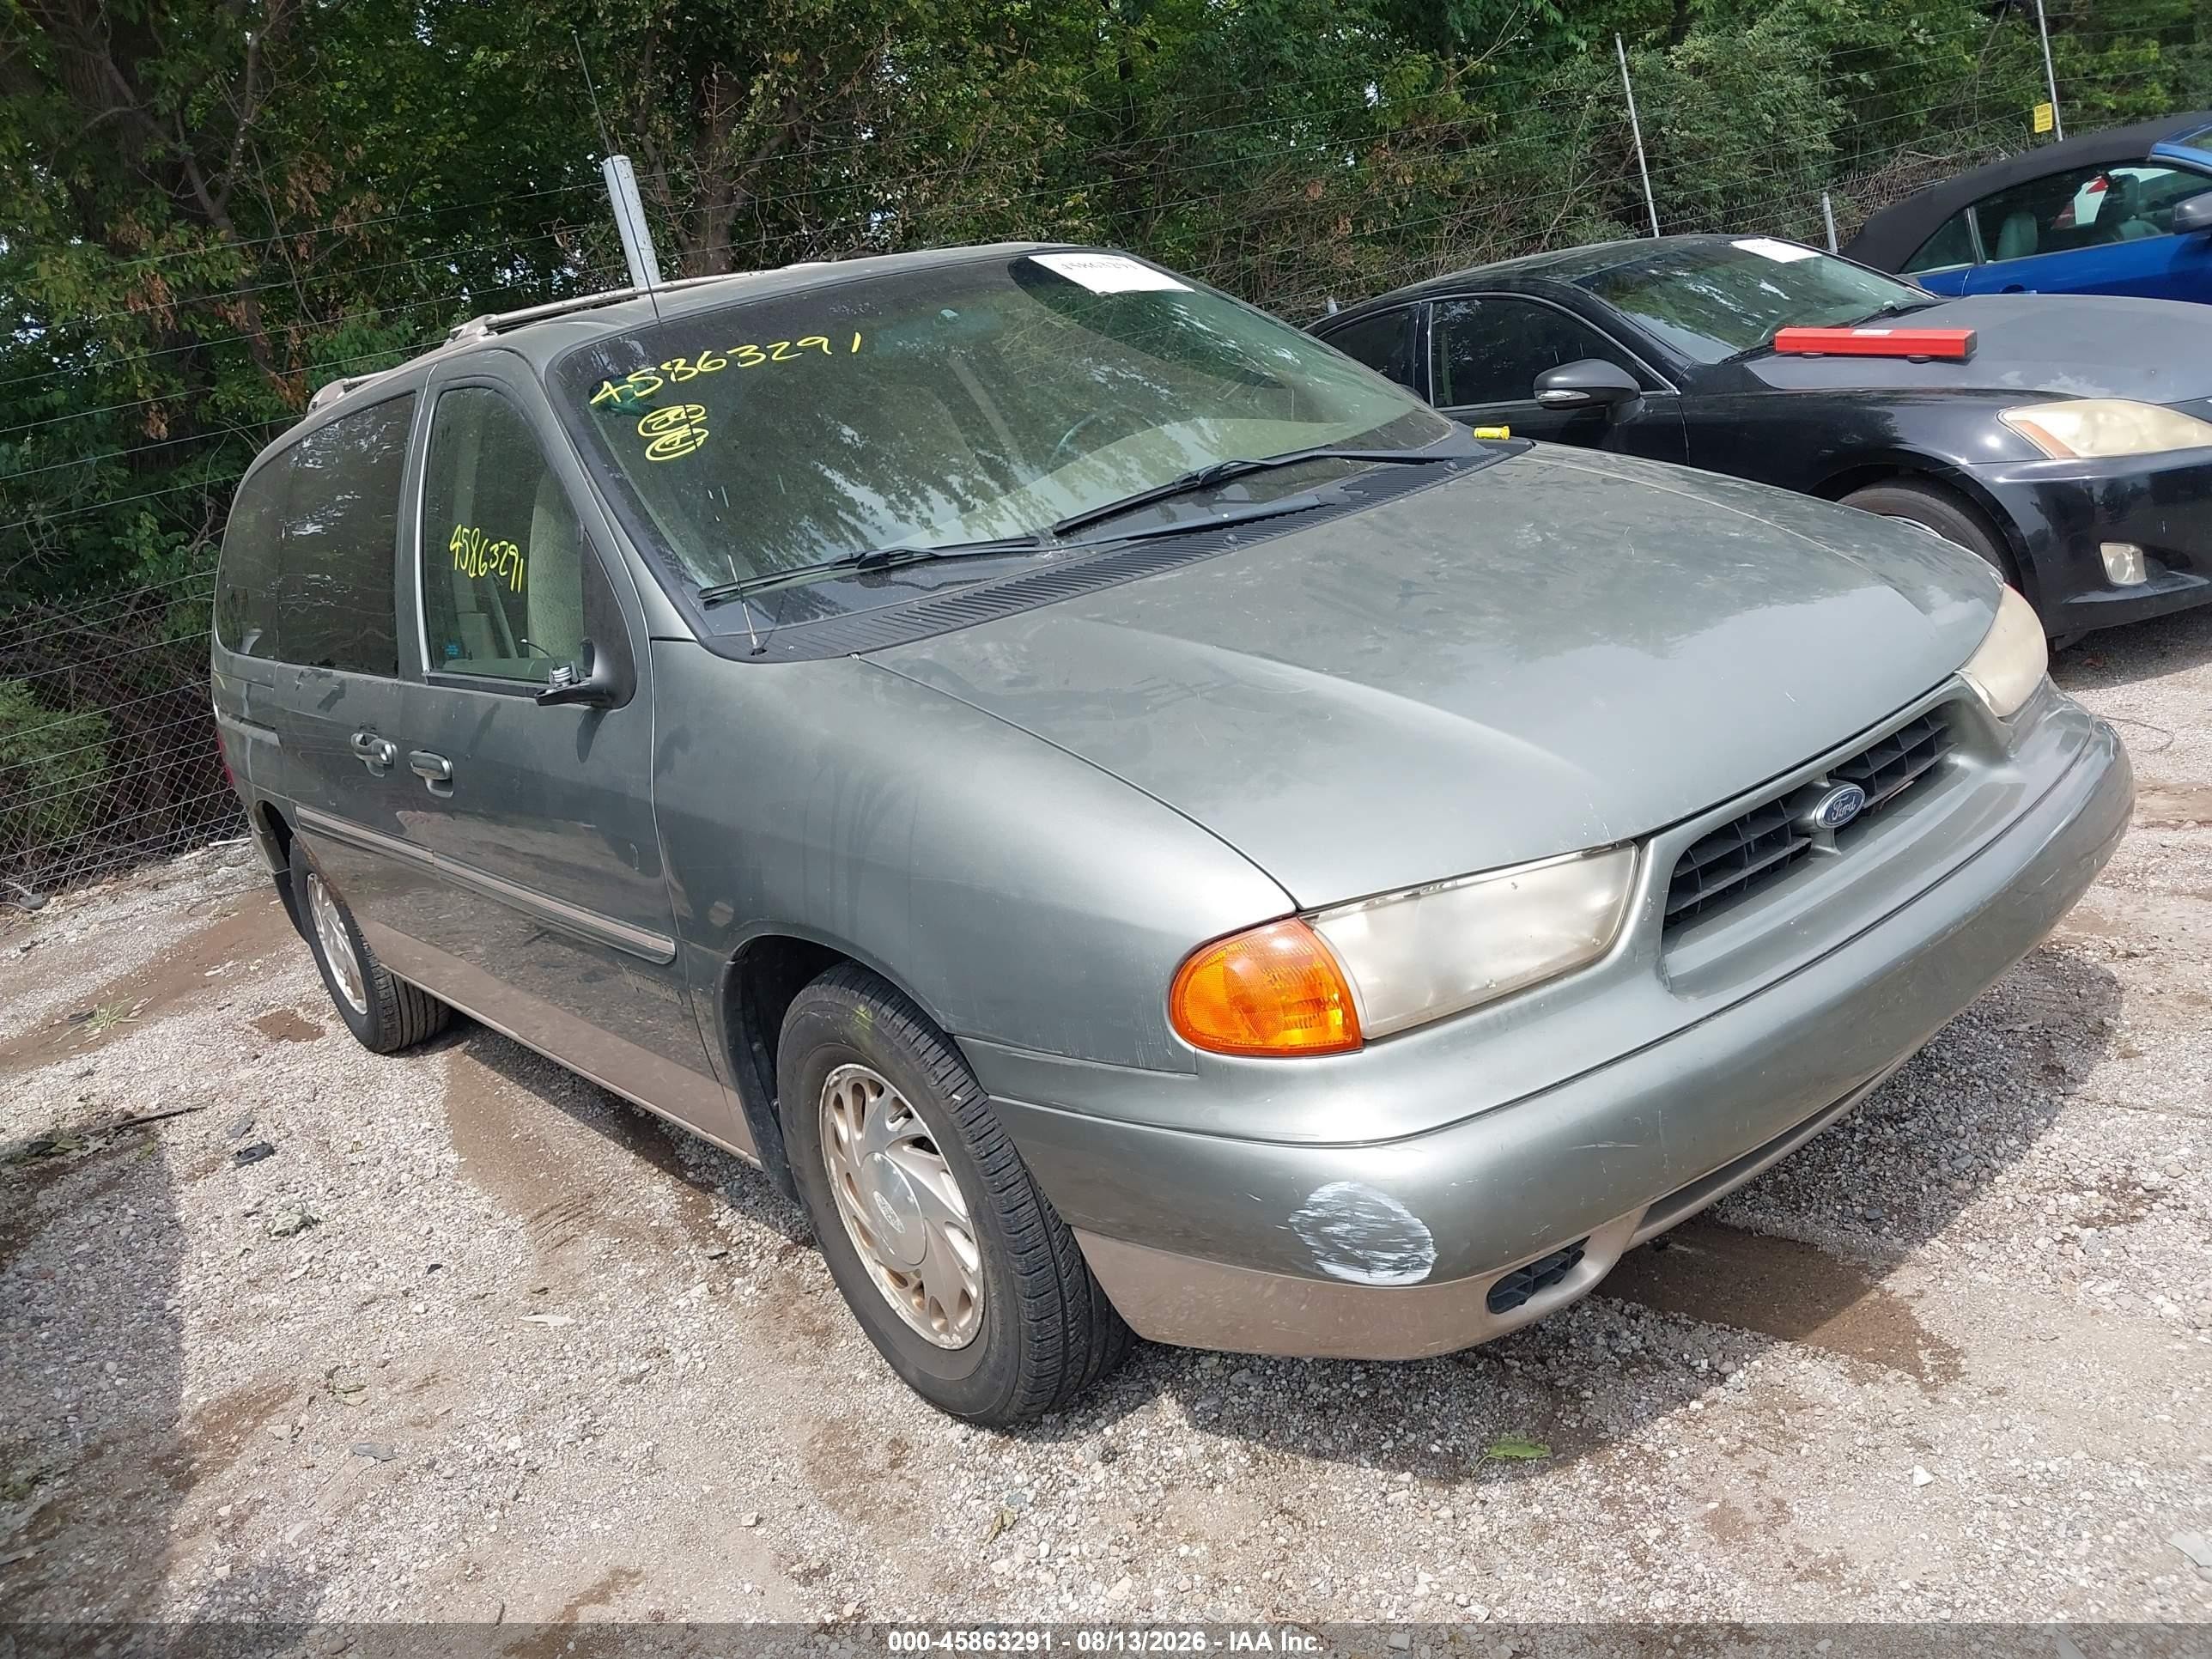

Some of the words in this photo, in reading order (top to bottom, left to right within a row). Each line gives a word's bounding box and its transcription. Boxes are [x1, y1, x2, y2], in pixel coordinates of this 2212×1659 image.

[589, 331, 862, 404] 45863291
[449, 523, 524, 593] 45863291
[1831, 794, 1857, 821] Ford
